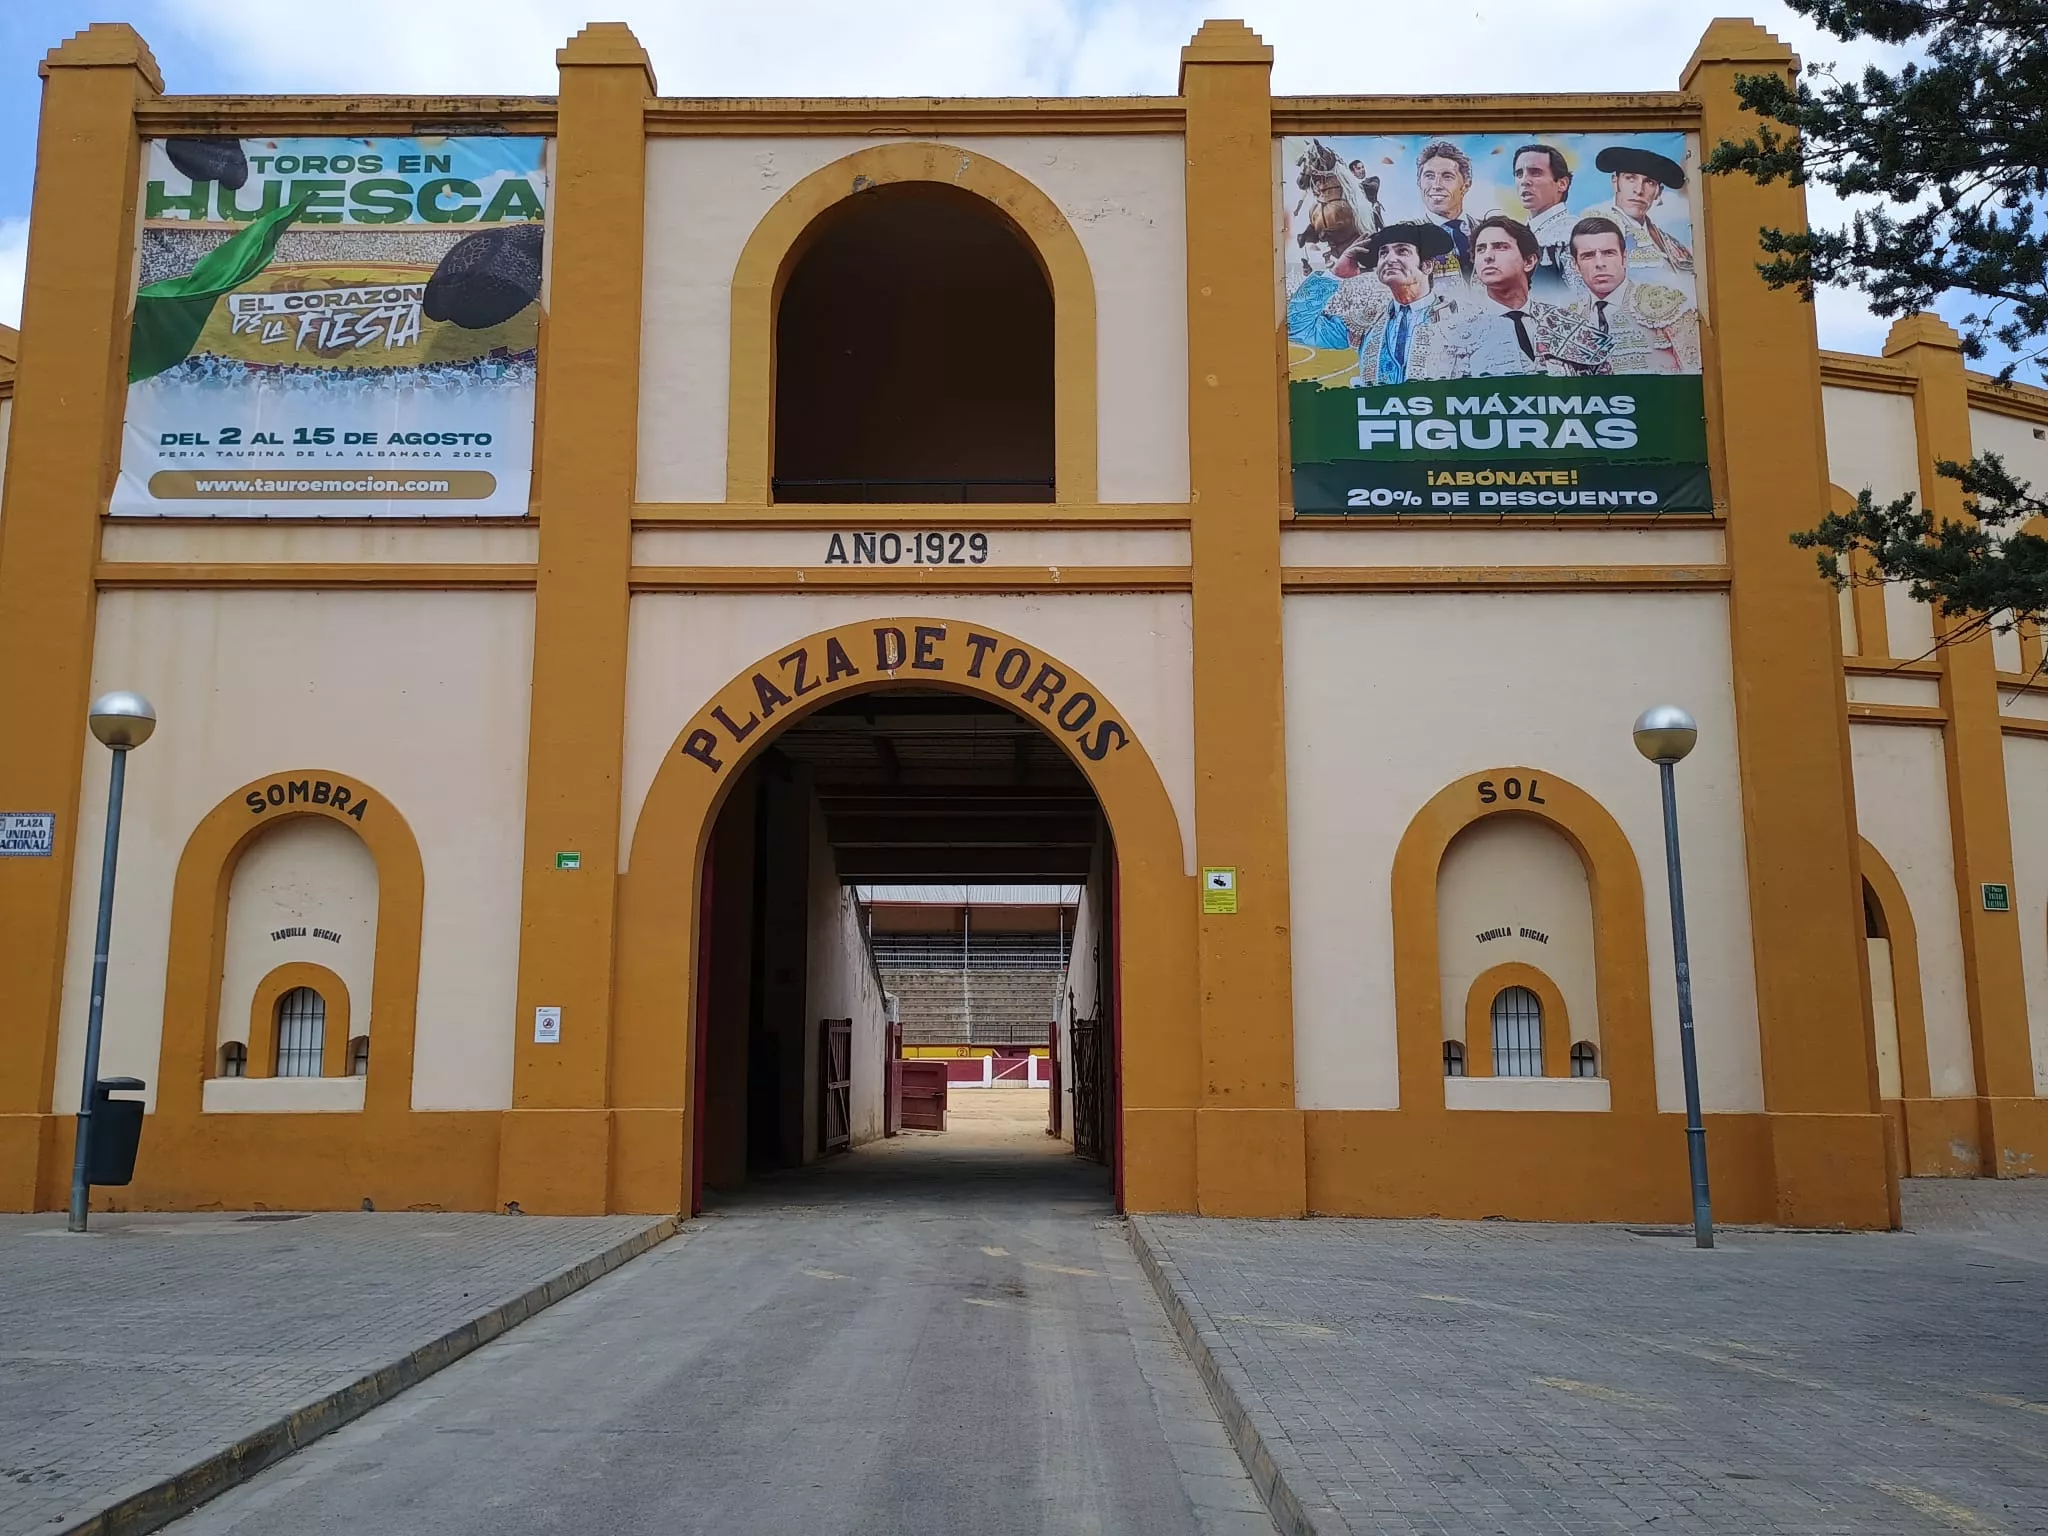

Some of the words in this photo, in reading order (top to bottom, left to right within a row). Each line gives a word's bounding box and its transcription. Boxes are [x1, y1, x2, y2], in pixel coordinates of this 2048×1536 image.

[250, 155, 383, 174] TOROS
[398, 155, 451, 174] EN
[146, 178, 544, 224] HUESCA
[239, 298, 274, 312] EL
[285, 288, 423, 310] CORAZÓN
[232, 312, 263, 335] DE
[261, 320, 287, 341] LA
[1357, 396, 1433, 416] LAS
[1446, 392, 1636, 415] MÁXIMAS
[160, 432, 210, 446] DEL
[218, 427, 242, 445] 2
[250, 432, 284, 445] AL
[293, 427, 336, 445] 15
[344, 432, 378, 445] DE
[387, 432, 493, 446] AGOSTO
[1358, 418, 1639, 450] FIGURAS
[216, 450, 286, 458] TAURINA
[355, 450, 442, 458] ALBAHACA
[195, 476, 450, 493] www.tauroemocion.com
[1427, 468, 1579, 486] ¡ABÓNATE!
[1347, 488, 1422, 507] 20%
[1432, 491, 1470, 506] DE
[1479, 490, 1659, 506] DESCUENTO
[681, 636, 860, 774] PLAZA
[873, 626, 947, 671] DE
[966, 632, 1130, 762] TOROS
[1478, 777, 1546, 805] SOL
[246, 780, 368, 822] SOMBRA
[15, 818, 44, 828] PLAZA
[5, 830, 46, 839] UNIDAD
[0, 839, 49, 850] ACIONAL
[270, 927, 307, 942] TAQUILLA
[312, 928, 342, 944] OFICIAL
[1475, 926, 1512, 944] TAQUILLA
[1519, 927, 1550, 944] OFICIAL
